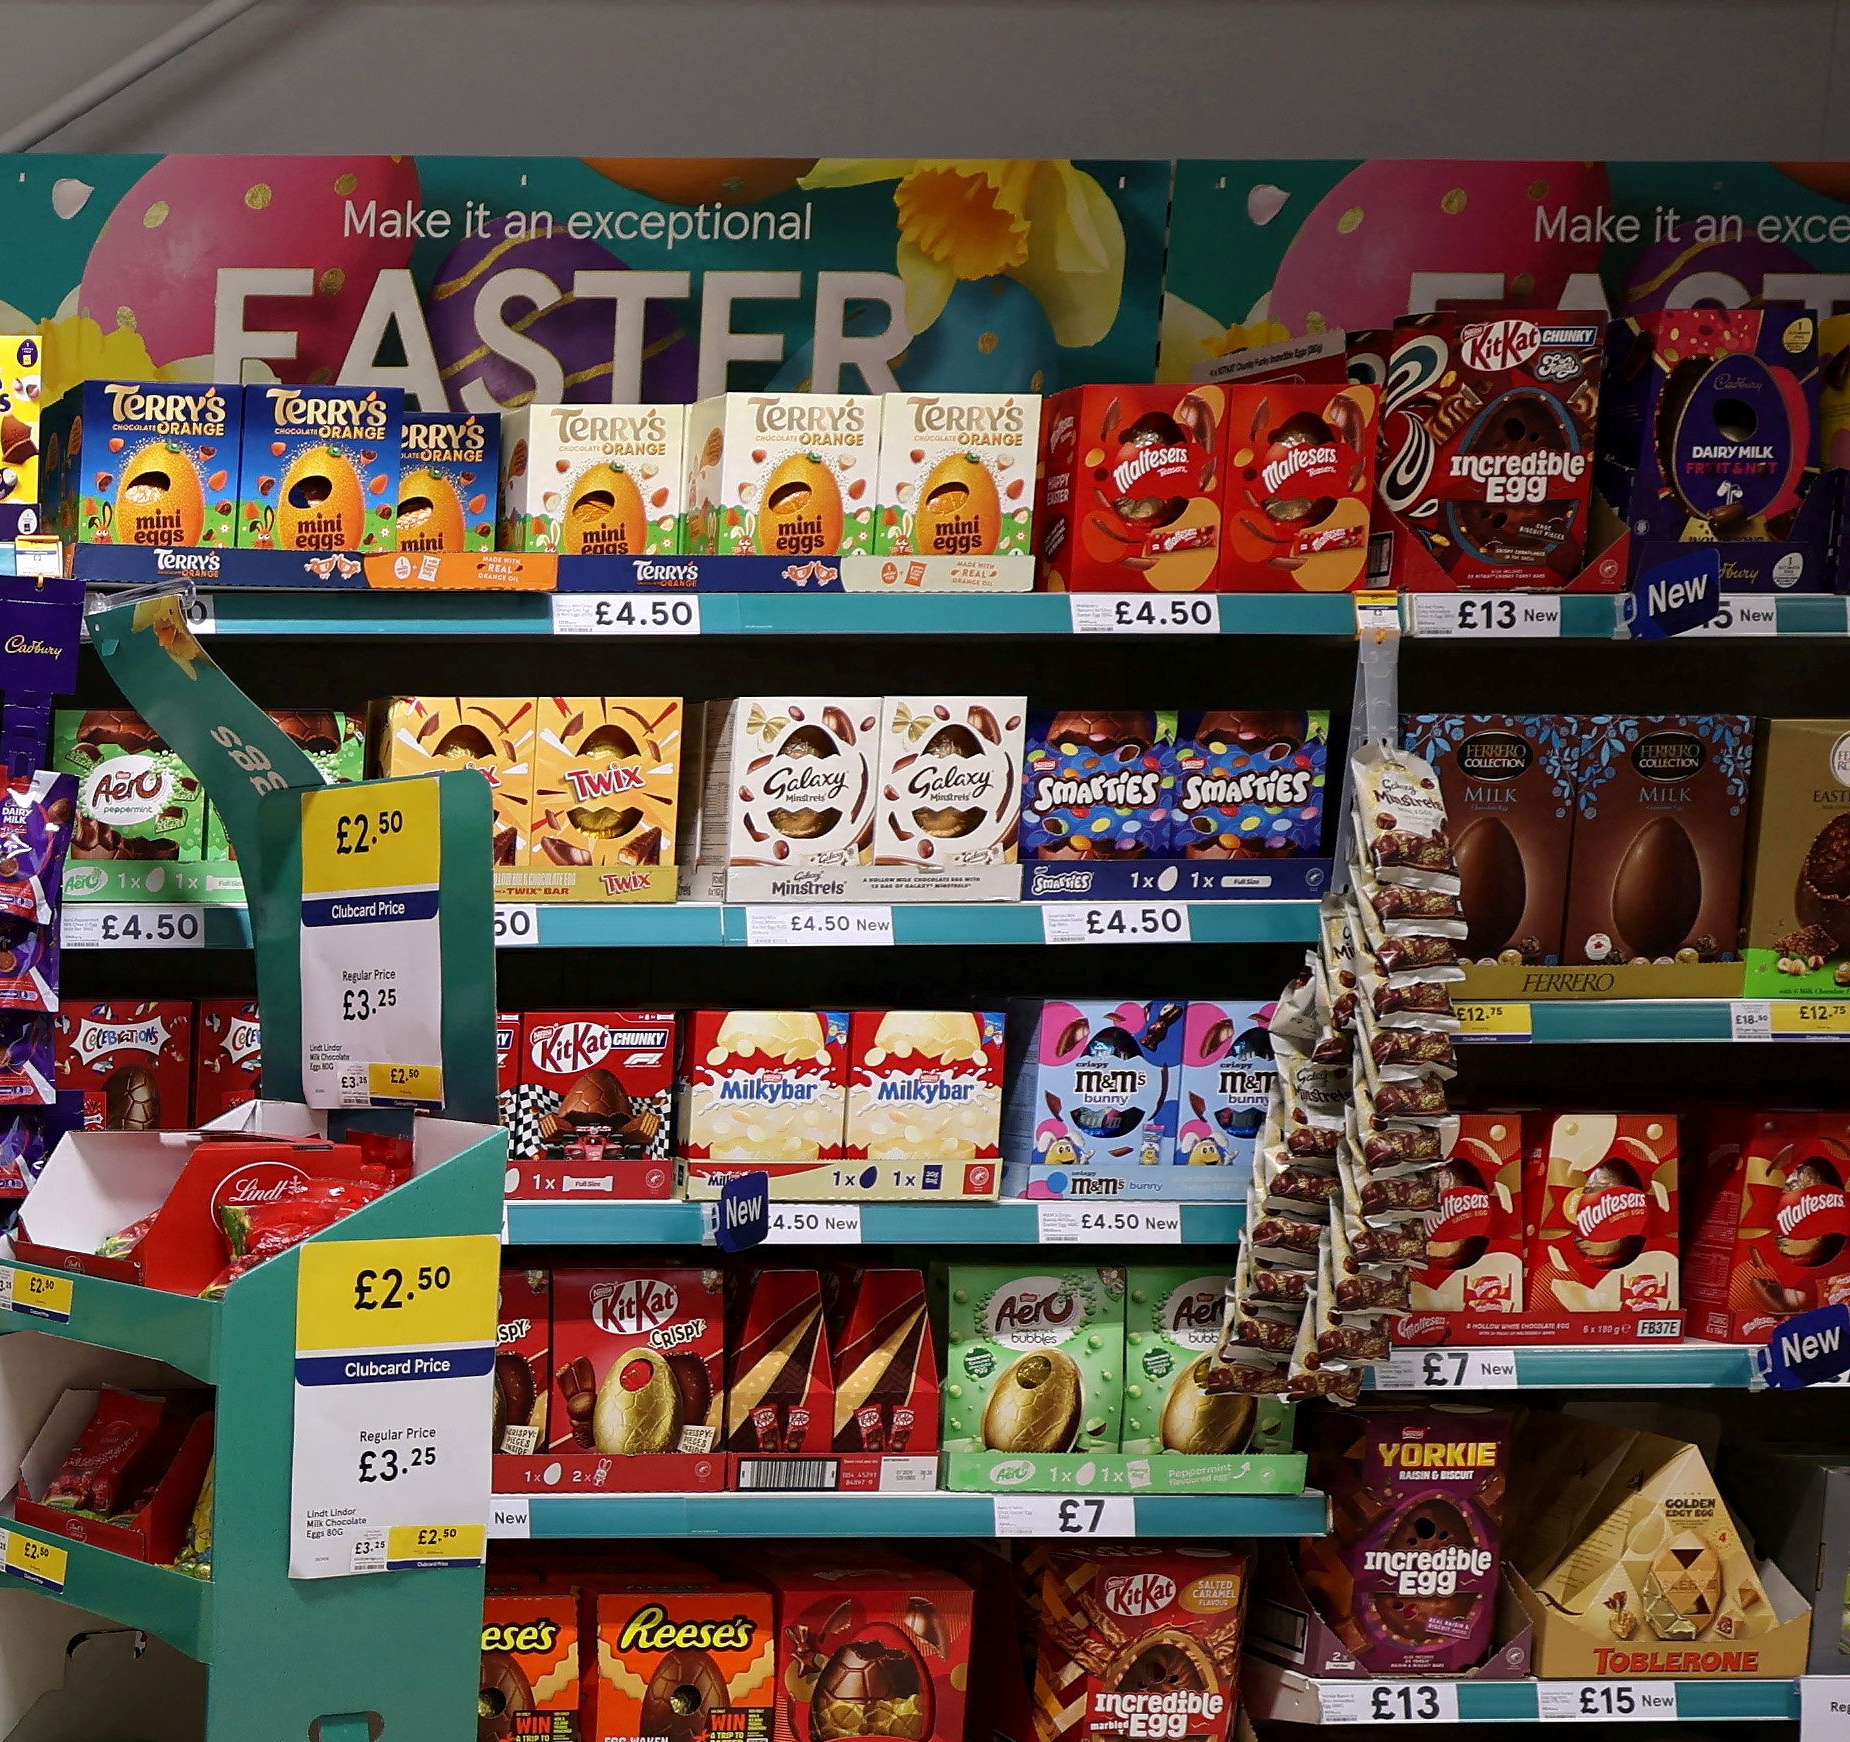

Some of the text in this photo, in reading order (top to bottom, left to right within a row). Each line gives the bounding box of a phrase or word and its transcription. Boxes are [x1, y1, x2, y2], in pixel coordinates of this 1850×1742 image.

[344, 201, 812, 247] Make it an exceptional
[1535, 205, 1646, 246] Make
[1653, 204, 1687, 243] it
[1695, 211, 1747, 243] an
[214, 267, 913, 413] EASTER
[1542, 328, 1594, 343] CHUNKY
[108, 385, 225, 422] TERRY'S
[554, 408, 666, 444] TERRY'S
[1112, 442, 1189, 494] Maltesers
[1649, 573, 1708, 615] New
[595, 599, 693, 627] £4.50
[1115, 601, 1212, 626] £4.50
[1458, 602, 1558, 630] £13 New
[1464, 758, 1526, 769] COLLECTION
[785, 792, 825, 802] Minstrels
[331, 901, 405, 918] Clubcard Price
[101, 915, 198, 941] £4.50
[791, 916, 889, 932] £4.50 New
[1087, 910, 1181, 935] £4.50
[1522, 973, 1614, 992] FERRERO
[611, 1032, 666, 1046] CHUNKY
[721, 1079, 819, 1101] Milkybar
[345, 1358, 450, 1378] Clubcard Price
[359, 1427, 436, 1442] Regular Price
[1378, 1441, 1497, 1468] YORKIE
[307, 1509, 356, 1519] Lindt Lindor
[307, 1518, 367, 1528] Milk Chocolate
[1058, 1500, 1104, 1532] £7
[307, 1529, 324, 1538] Eggs
[621, 1604, 753, 1650] Reese's
[1594, 1649, 1758, 1673] TOBLERONE
[1371, 1687, 1439, 1718] £13
[1579, 1687, 1673, 1714] £15 New
[711, 1713, 746, 1731] WIN
